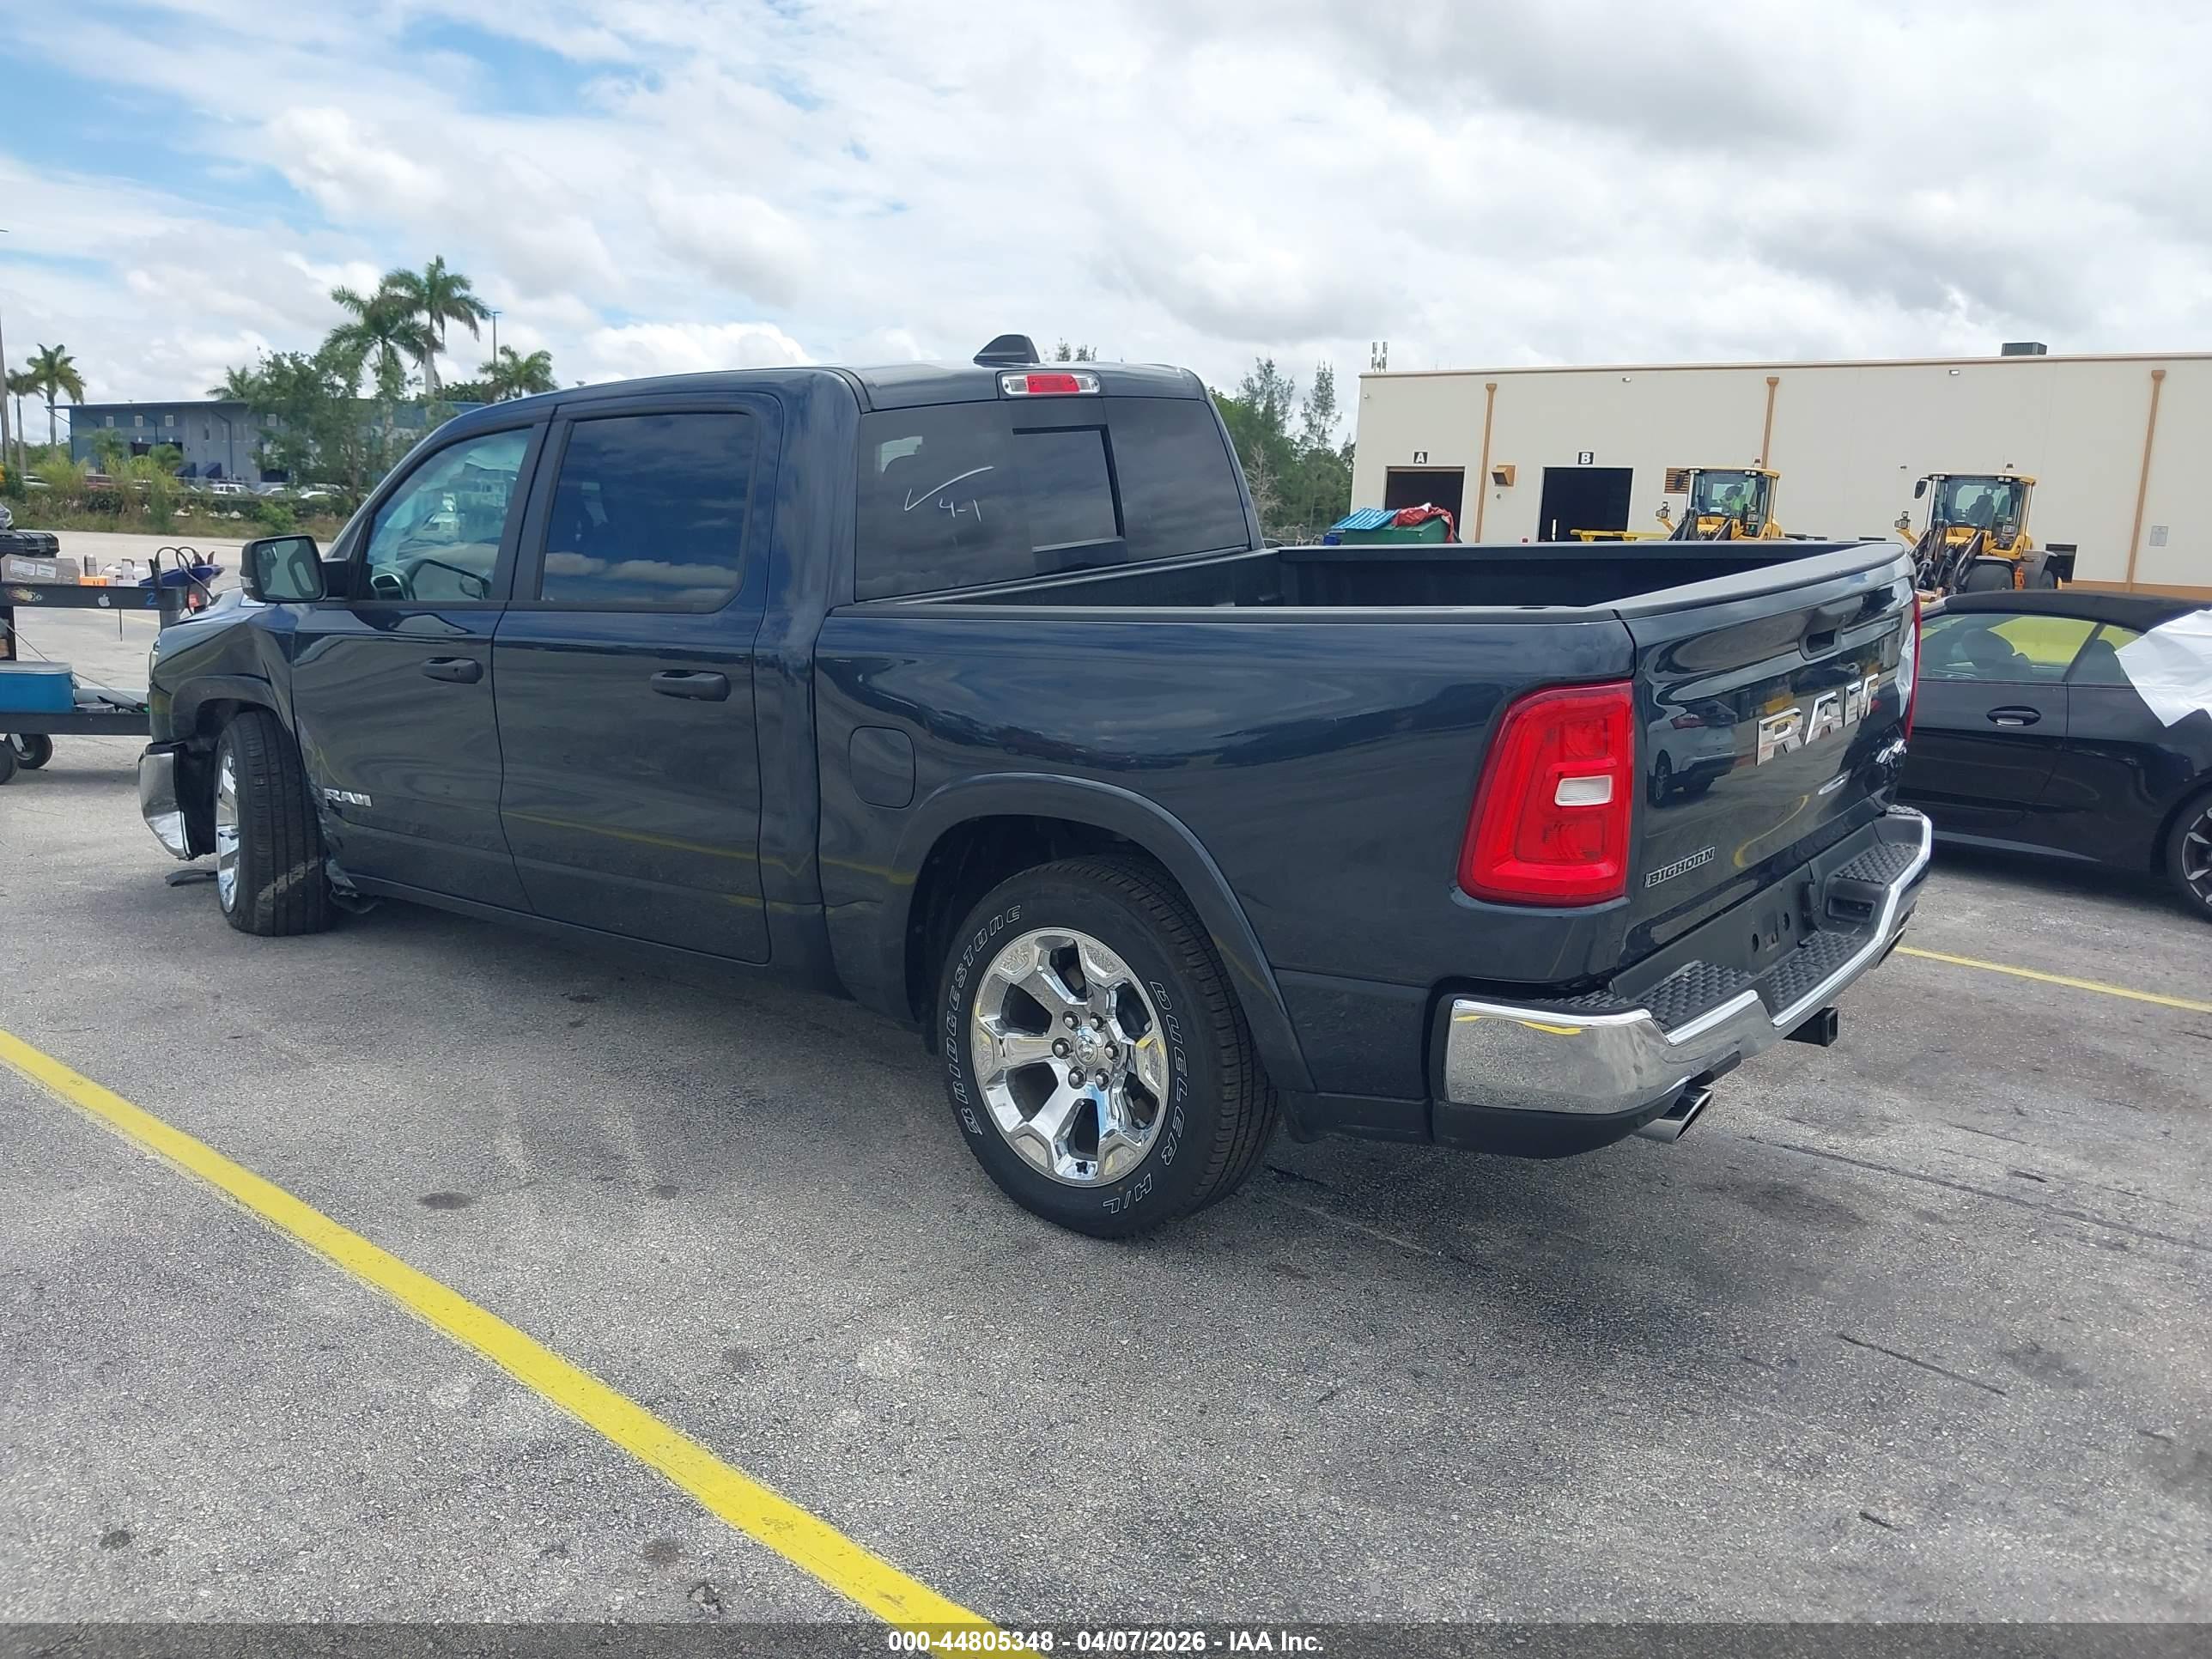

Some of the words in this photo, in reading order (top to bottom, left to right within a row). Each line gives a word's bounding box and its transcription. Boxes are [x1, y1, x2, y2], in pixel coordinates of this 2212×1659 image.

[939, 497, 982, 522] 4-1
[1756, 672, 1879, 766] RAM
[323, 787, 373, 807] RAM
[1644, 846, 1717, 889] BIGHORN
[946, 904, 1022, 1136] BRIDGESTONE
[1149, 981, 1188, 1166] DUELER
[1103, 1172, 1152, 1214] H/L
